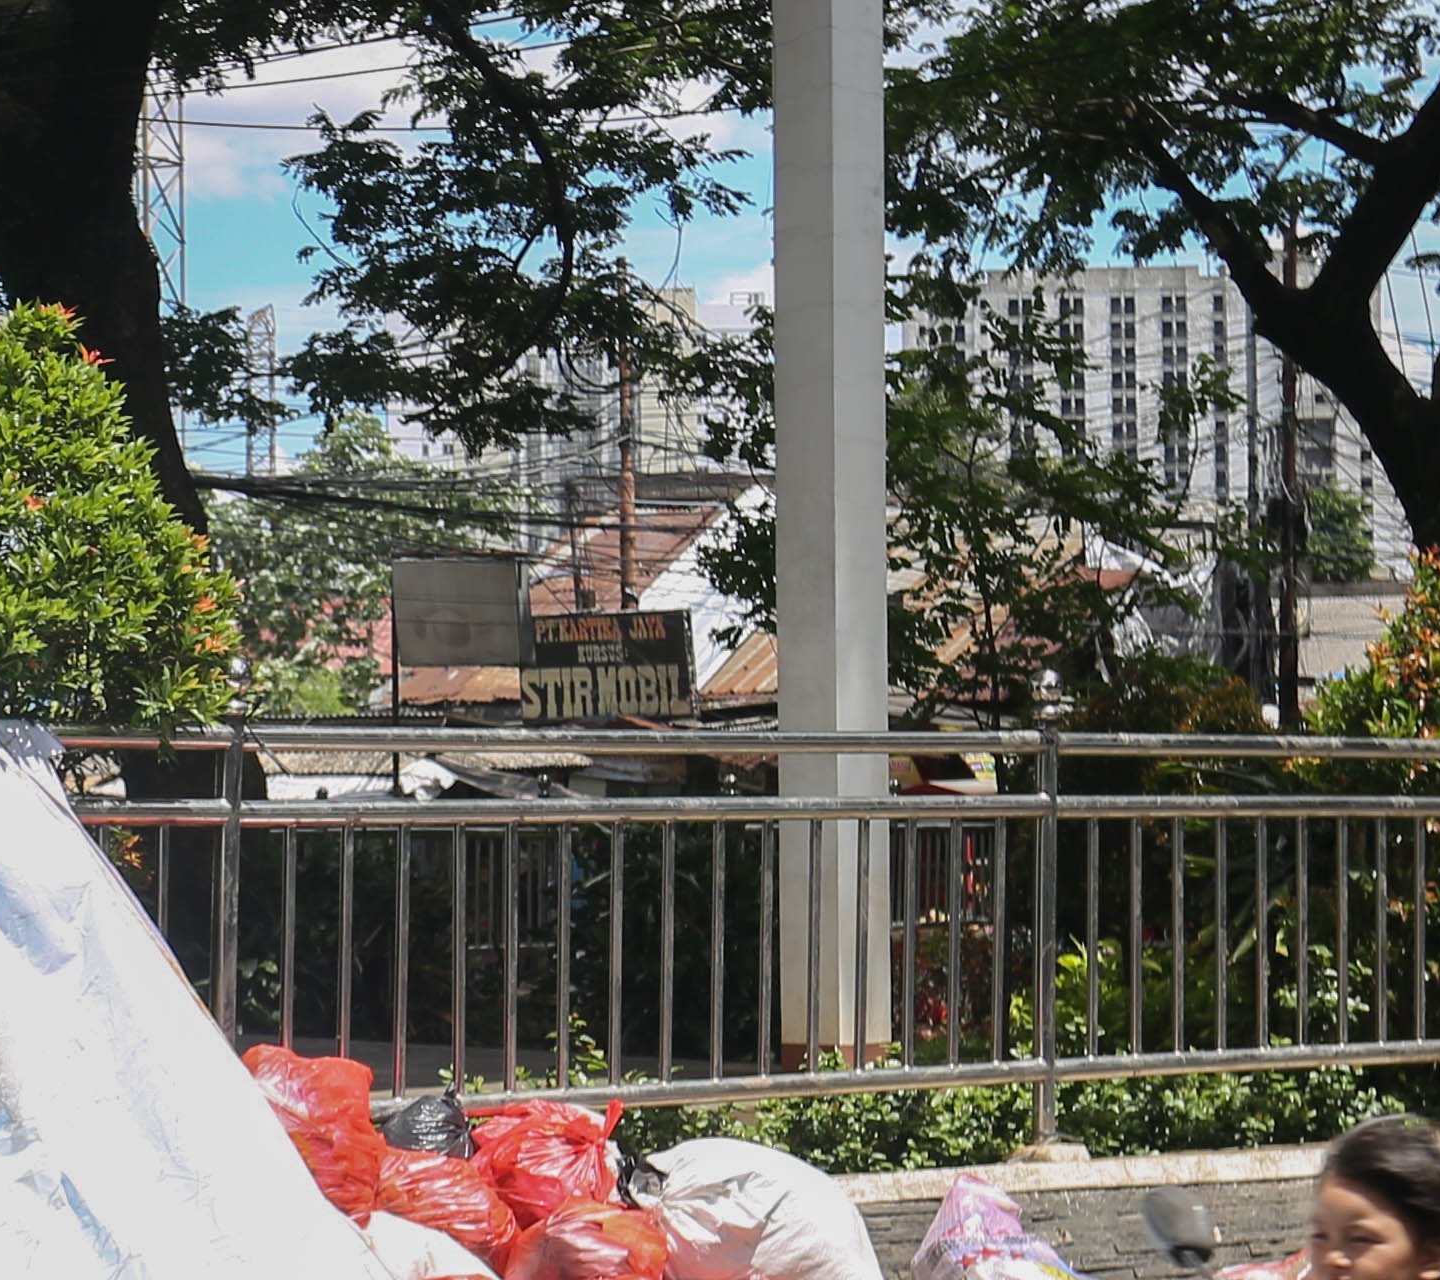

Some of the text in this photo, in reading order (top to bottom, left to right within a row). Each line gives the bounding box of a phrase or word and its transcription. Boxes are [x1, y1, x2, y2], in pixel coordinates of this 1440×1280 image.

[629, 616, 666, 641] JAYA
[522, 664, 693, 719] STIR MOBIL
